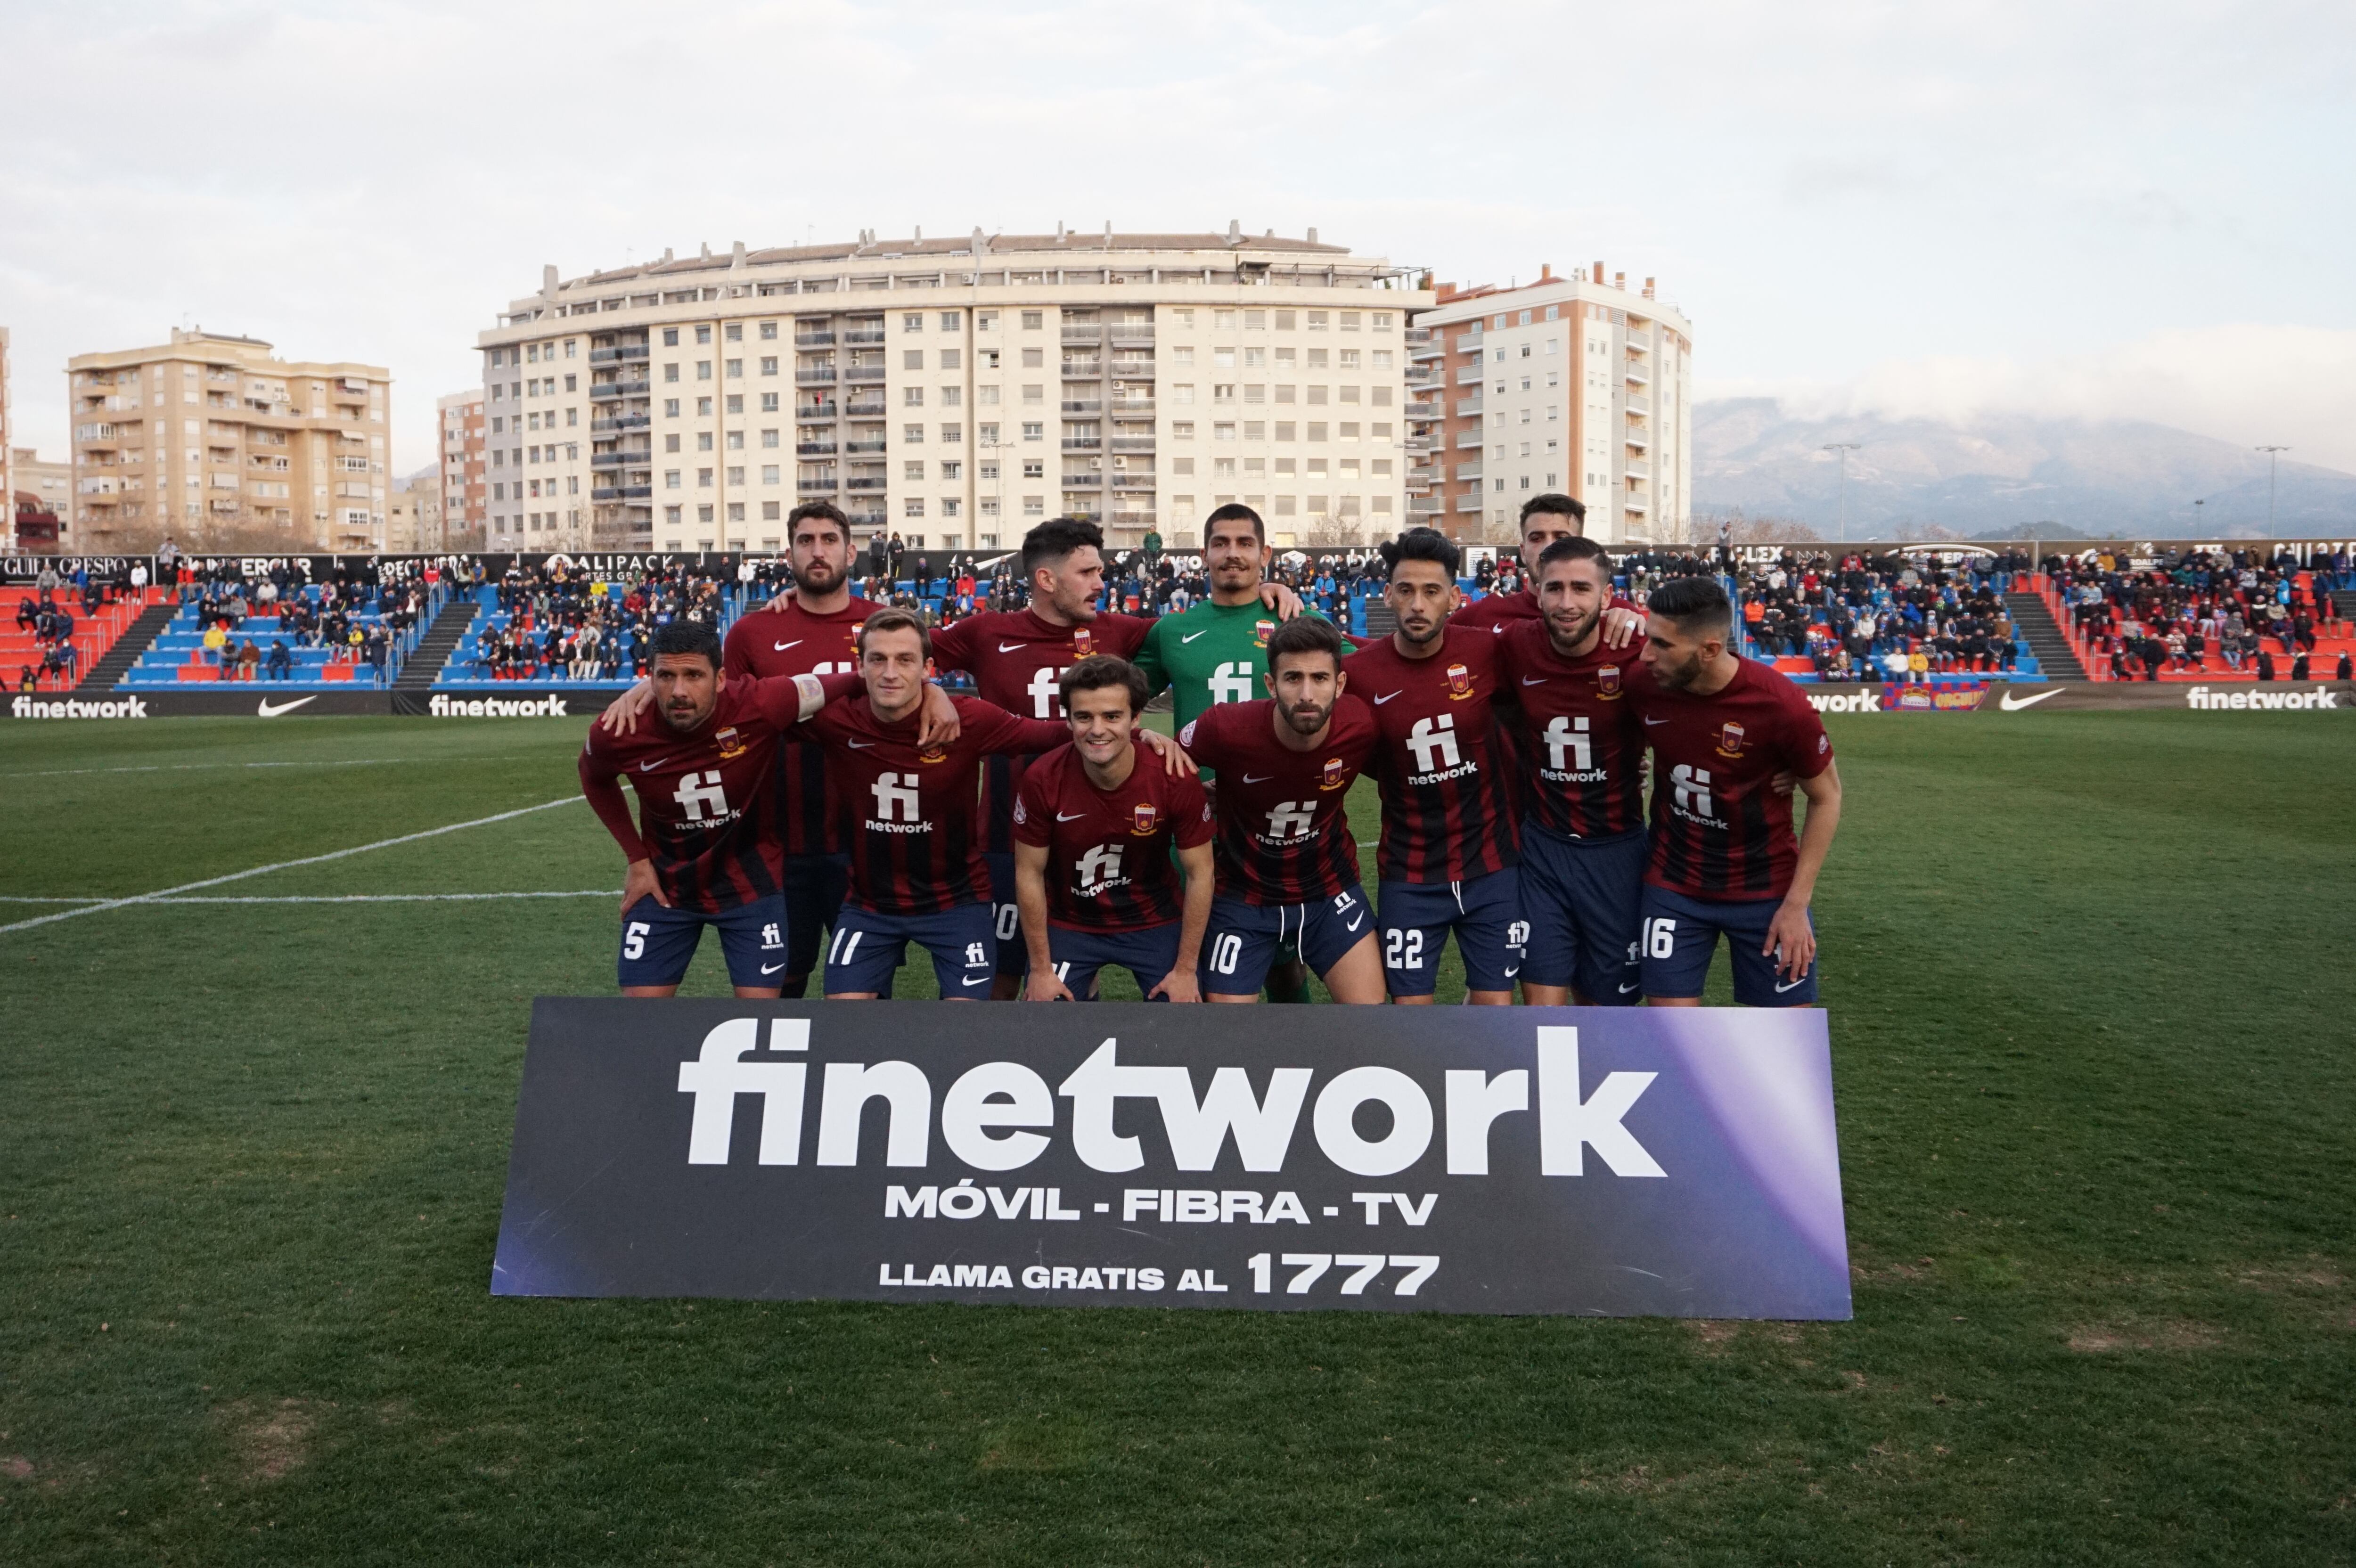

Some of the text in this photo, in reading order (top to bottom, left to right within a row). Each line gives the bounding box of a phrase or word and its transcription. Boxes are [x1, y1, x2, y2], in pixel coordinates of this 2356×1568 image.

[1208, 662, 1252, 705] fi
[2186, 686, 2338, 709] finetwork
[12, 695, 147, 718] finetwork
[429, 694, 566, 716] finetwork
[1406, 713, 1461, 772] fi
[1543, 716, 1591, 769] fi
[1408, 760, 1478, 785] network
[1541, 768, 1607, 782] network
[1669, 764, 1713, 817] fi
[673, 770, 728, 820] fi
[871, 772, 919, 821] fi
[675, 808, 741, 830] network
[866, 818, 933, 833] network
[1255, 828, 1320, 846] network
[1265, 800, 1317, 838] fi
[1076, 844, 1124, 888] fi
[1071, 877, 1132, 898] network
[624, 922, 651, 959] 5
[761, 923, 780, 945] fi
[965, 942, 985, 963] fi
[1210, 932, 1242, 974] 10
[1386, 928, 1423, 969] 22
[1642, 917, 1676, 959] 16
[678, 1018, 1669, 1180] finetwork
[884, 1178, 1080, 1220] MÓVIL
[1123, 1189, 1311, 1224] FIBRA
[1352, 1192, 1439, 1226] TV
[879, 1253, 1440, 1296] LLAMA GRATIS AL 1777
